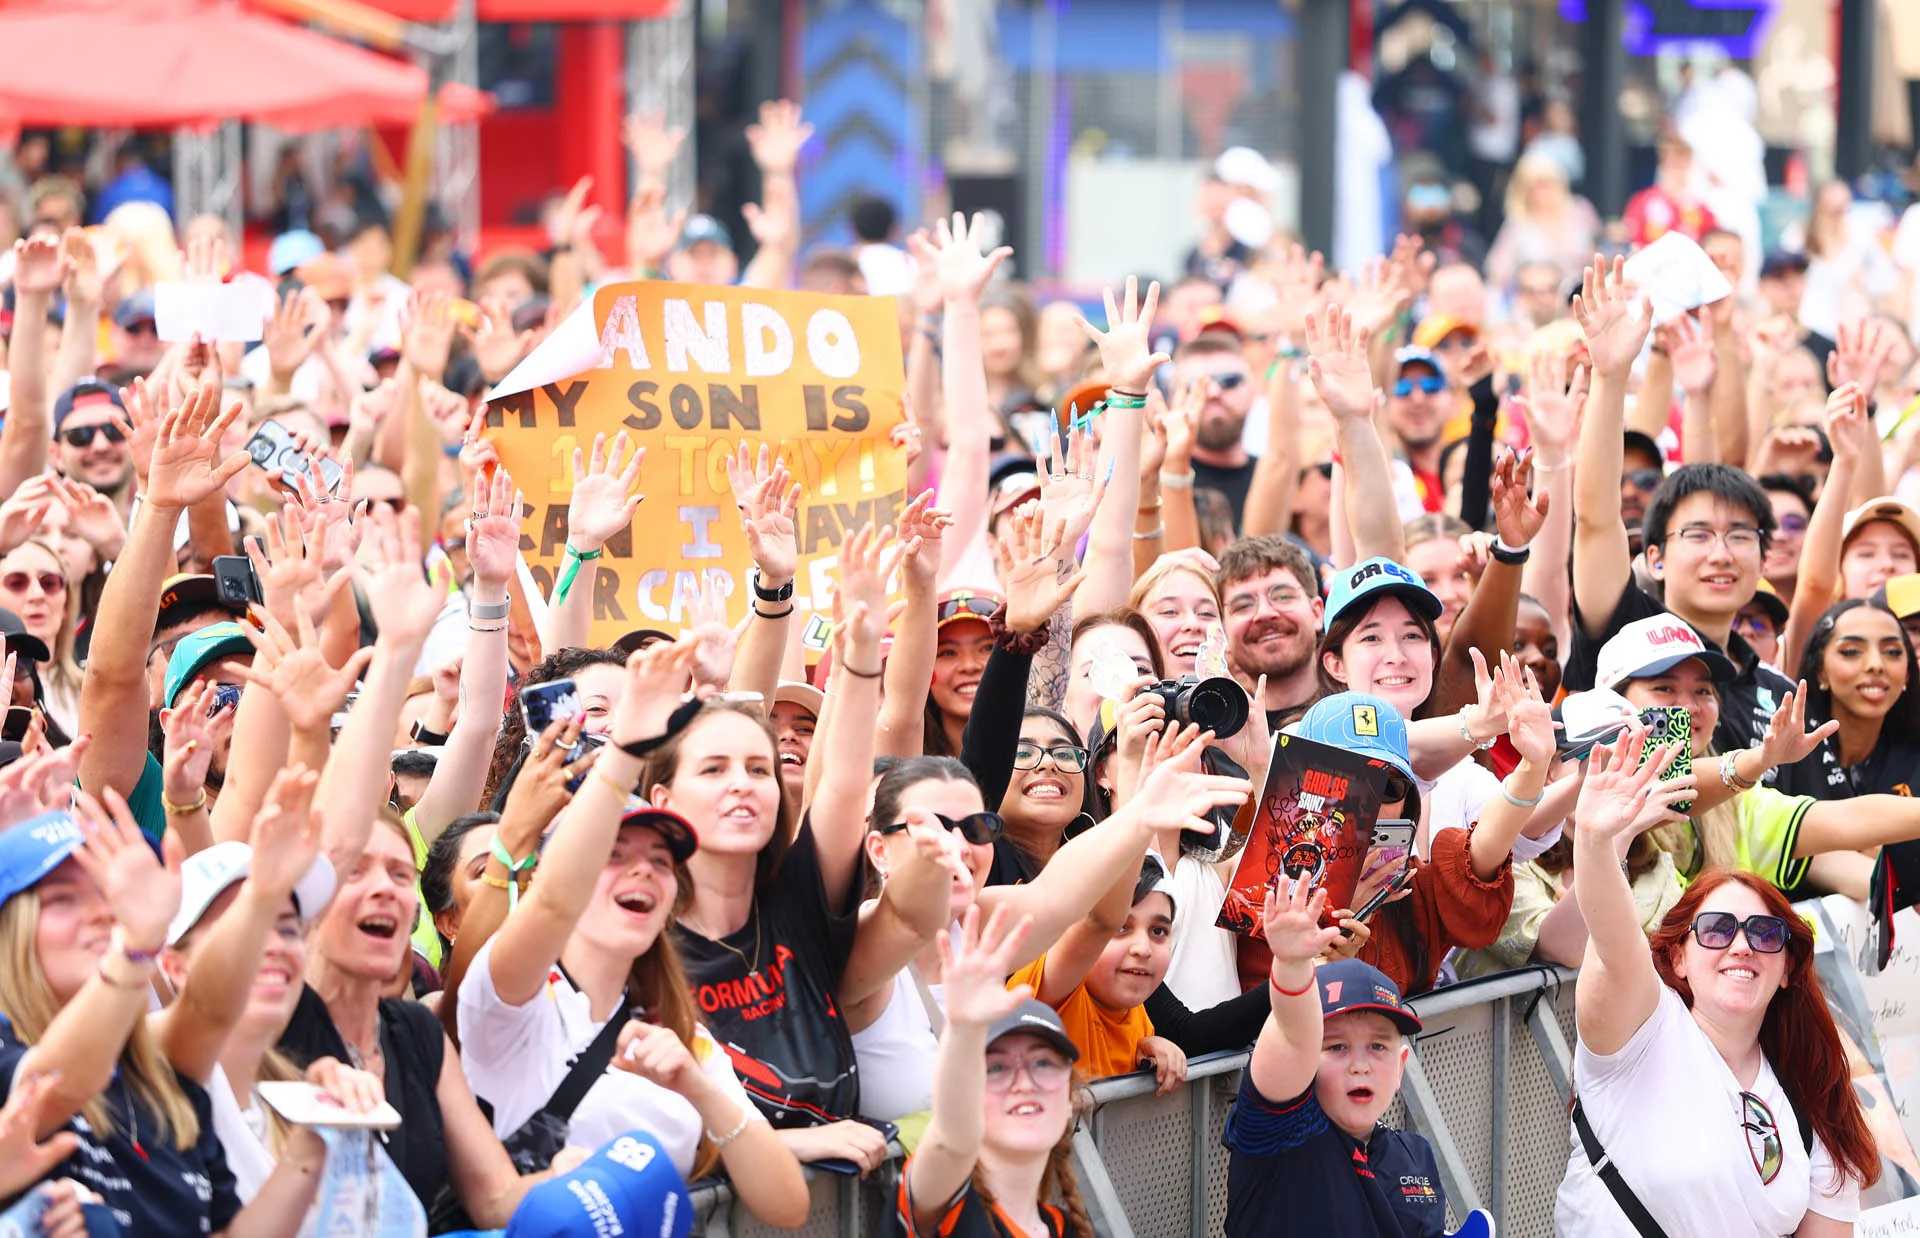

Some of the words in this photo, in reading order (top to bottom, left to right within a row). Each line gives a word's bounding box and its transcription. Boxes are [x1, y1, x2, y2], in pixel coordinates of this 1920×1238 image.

[596, 295, 862, 379] ANDO
[486, 381, 590, 429] MY
[622, 381, 762, 431] SON
[802, 384, 871, 432] IS
[679, 505, 723, 559] I
[794, 488, 906, 556] AVE
[1298, 791, 1326, 813] SAINZ
[1302, 769, 1349, 801] CARLOS
[1324, 980, 1344, 1005] 1
